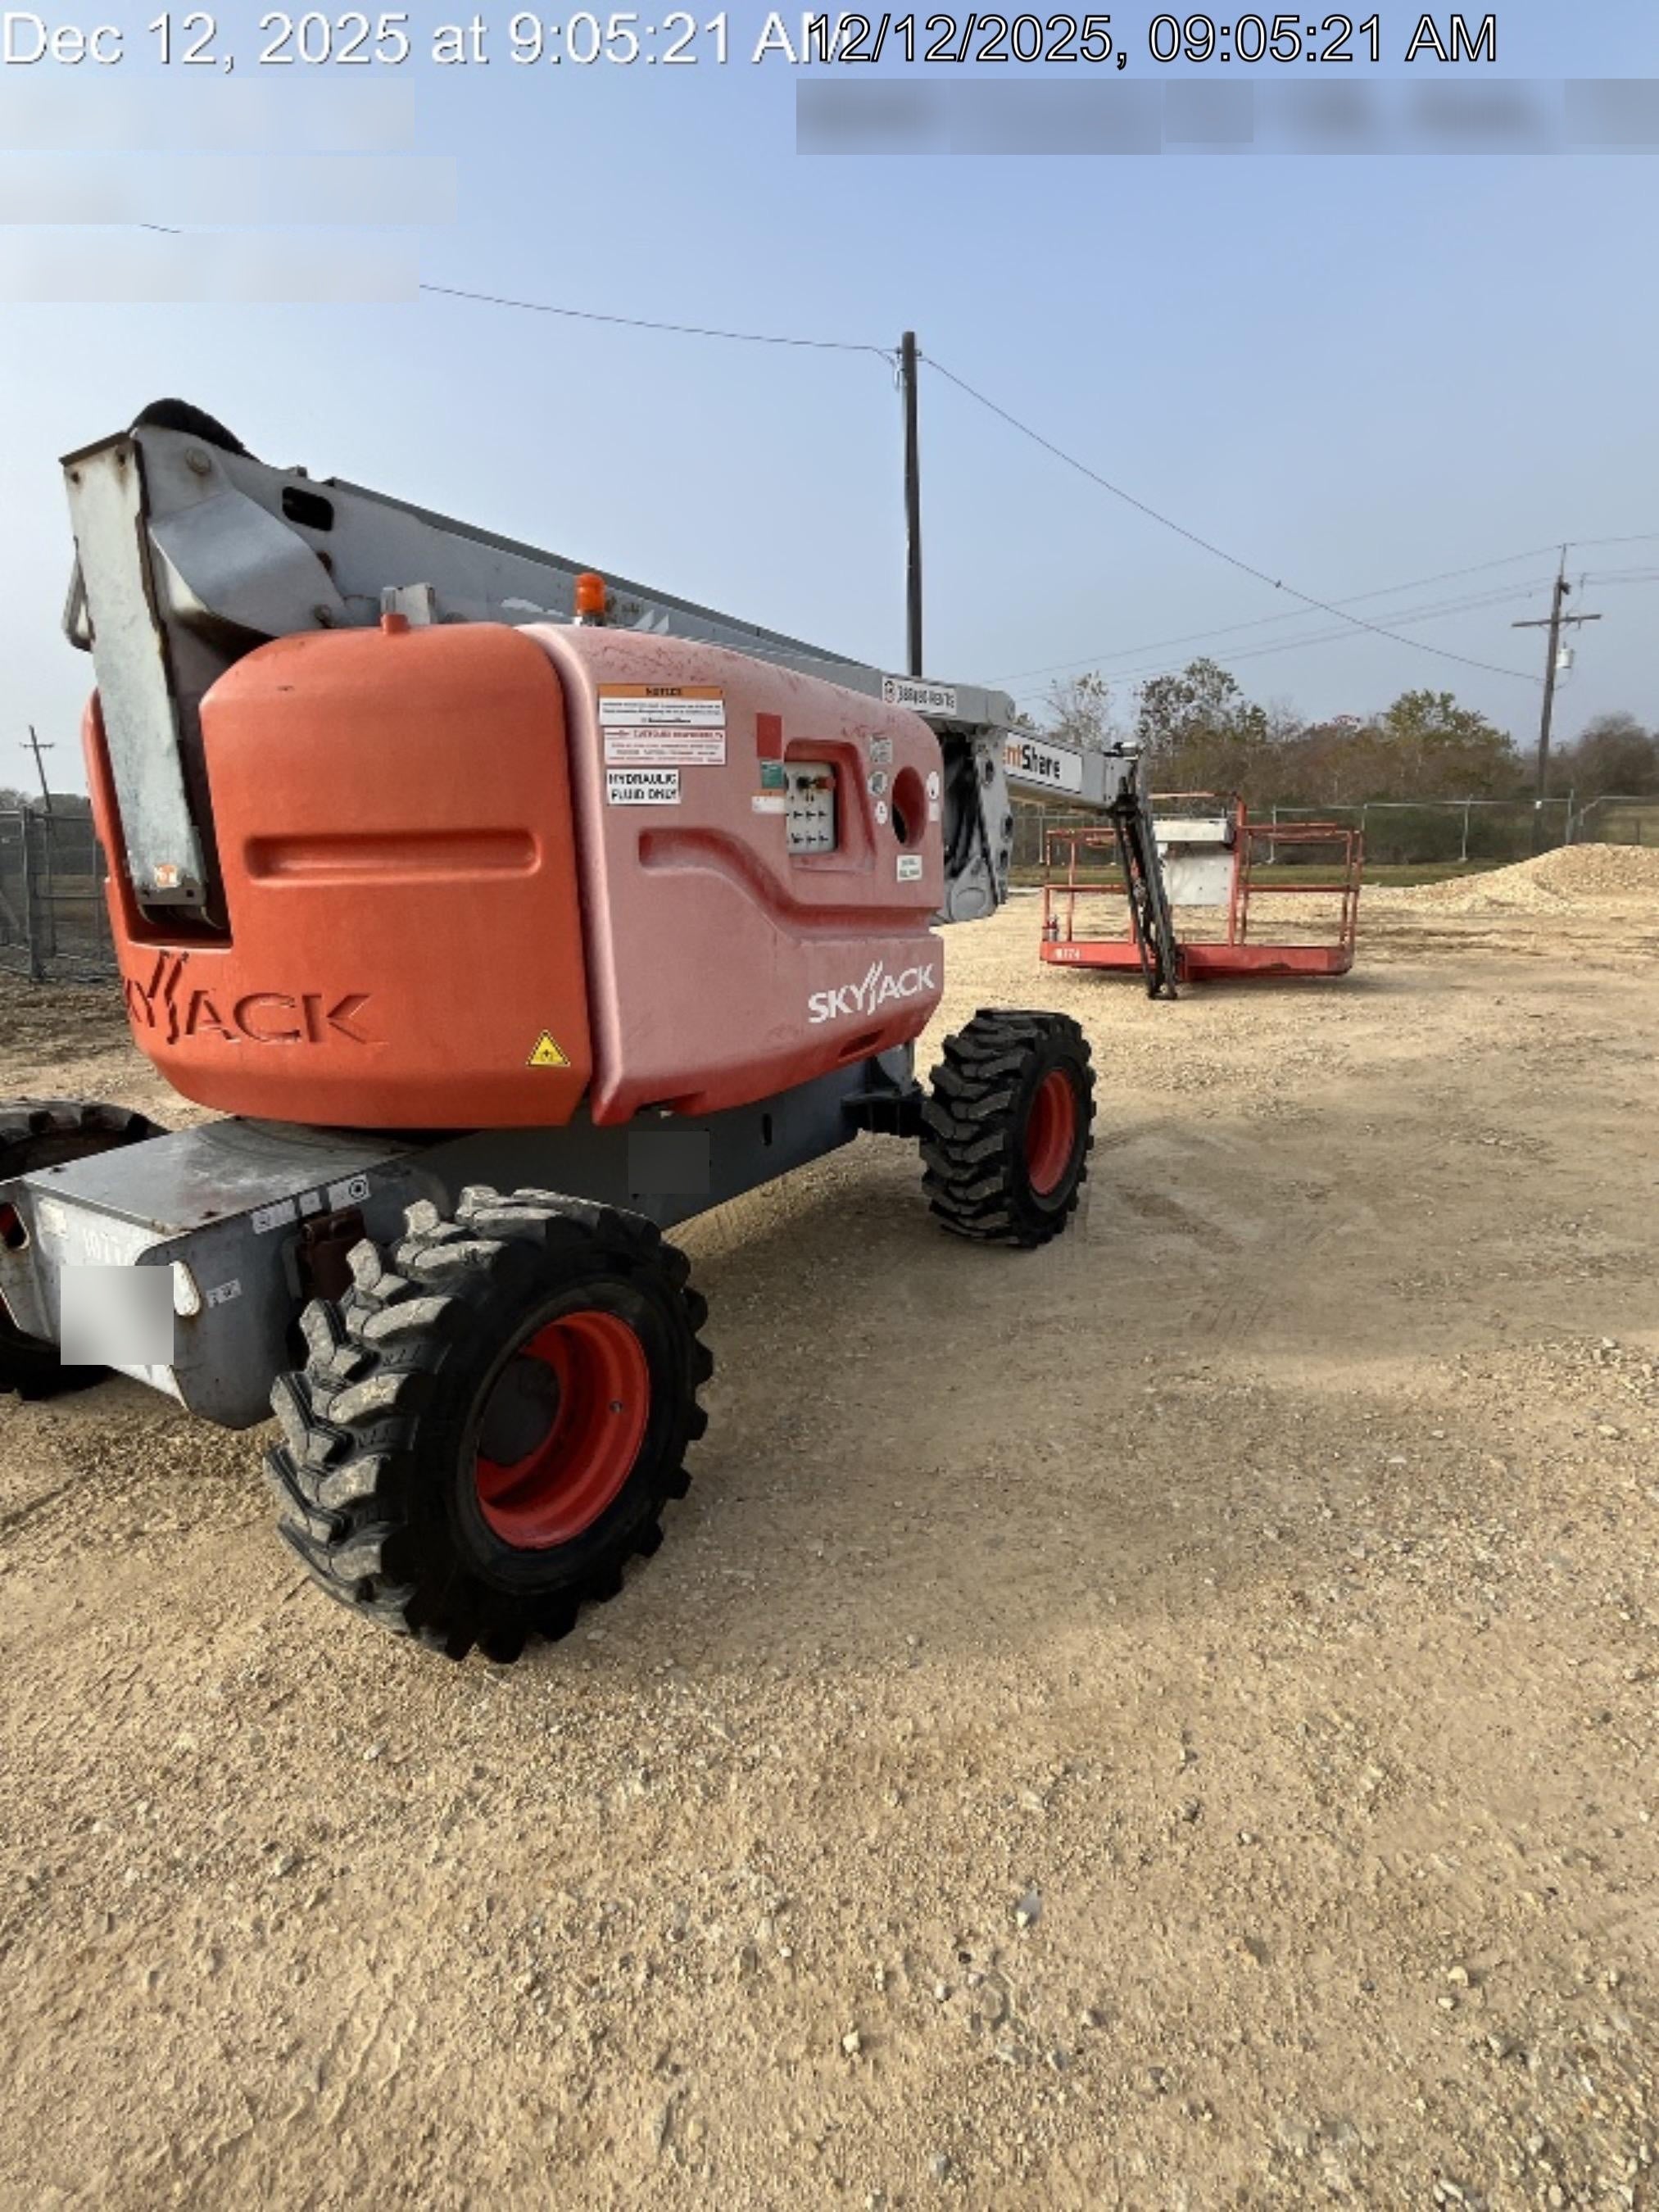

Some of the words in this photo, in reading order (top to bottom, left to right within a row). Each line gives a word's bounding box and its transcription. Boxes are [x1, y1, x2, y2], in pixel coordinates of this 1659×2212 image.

[609, 773, 677, 785] HYDRAULIC
[611, 788, 645, 800] FLUID
[648, 788, 677, 800] ONLY
[808, 960, 936, 1023] SKYJACK
